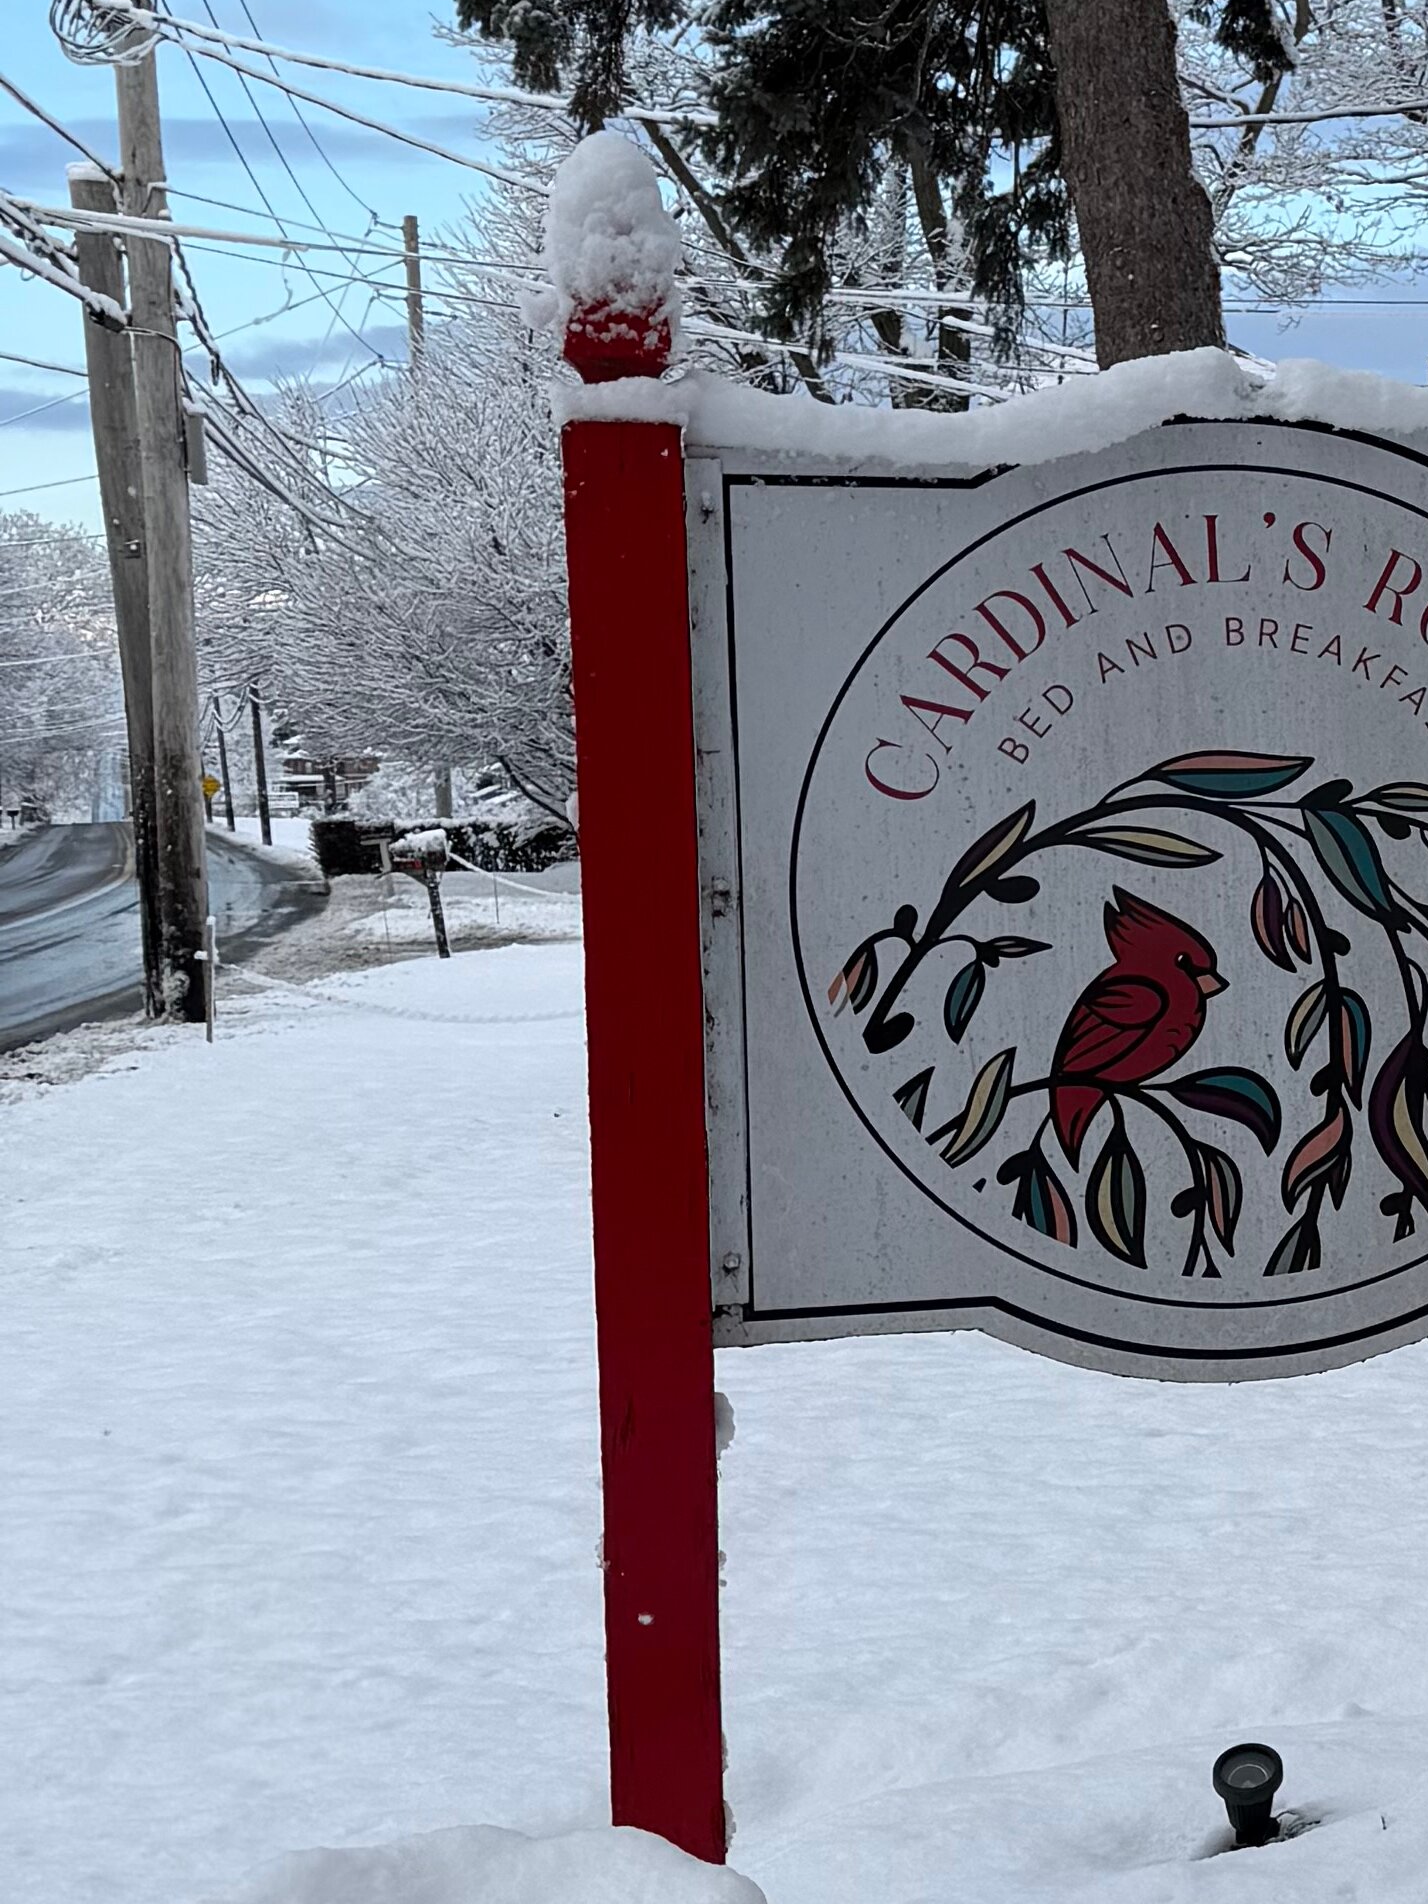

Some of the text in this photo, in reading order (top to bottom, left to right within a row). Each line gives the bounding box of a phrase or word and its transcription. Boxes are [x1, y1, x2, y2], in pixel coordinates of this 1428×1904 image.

[864, 513, 1333, 801] CARDINAL'S
[997, 684, 1074, 765] BED
[1097, 623, 1193, 685] AND
